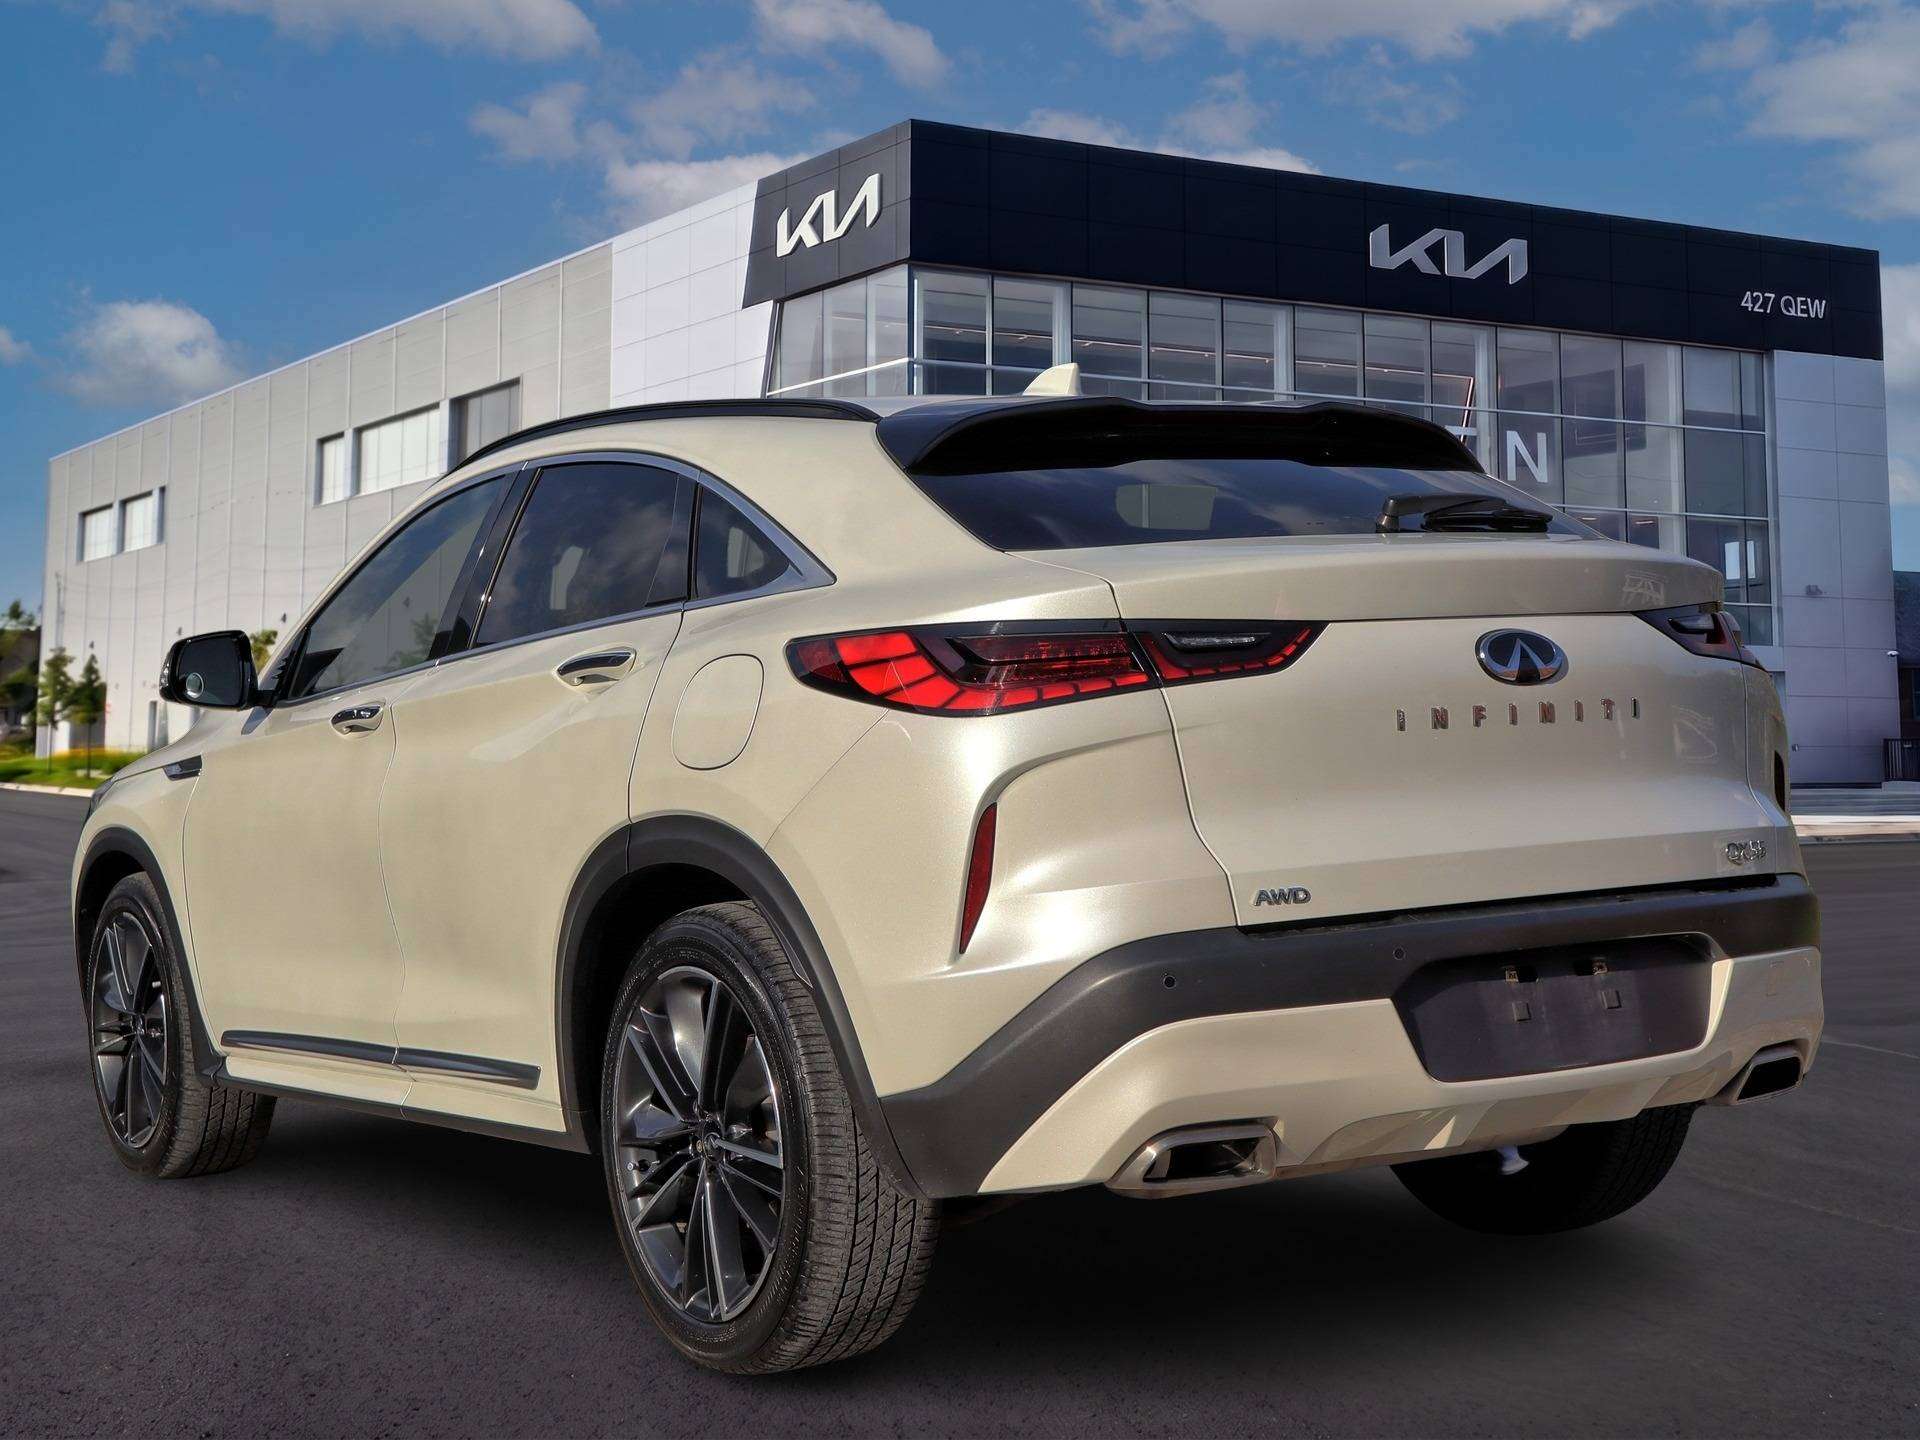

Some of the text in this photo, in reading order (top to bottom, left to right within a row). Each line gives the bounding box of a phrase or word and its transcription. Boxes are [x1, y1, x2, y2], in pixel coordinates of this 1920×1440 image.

[1740, 291, 1826, 319] 427 QEW
[1396, 697, 1640, 732] INFINITI
[1254, 886, 1312, 907] AWD
